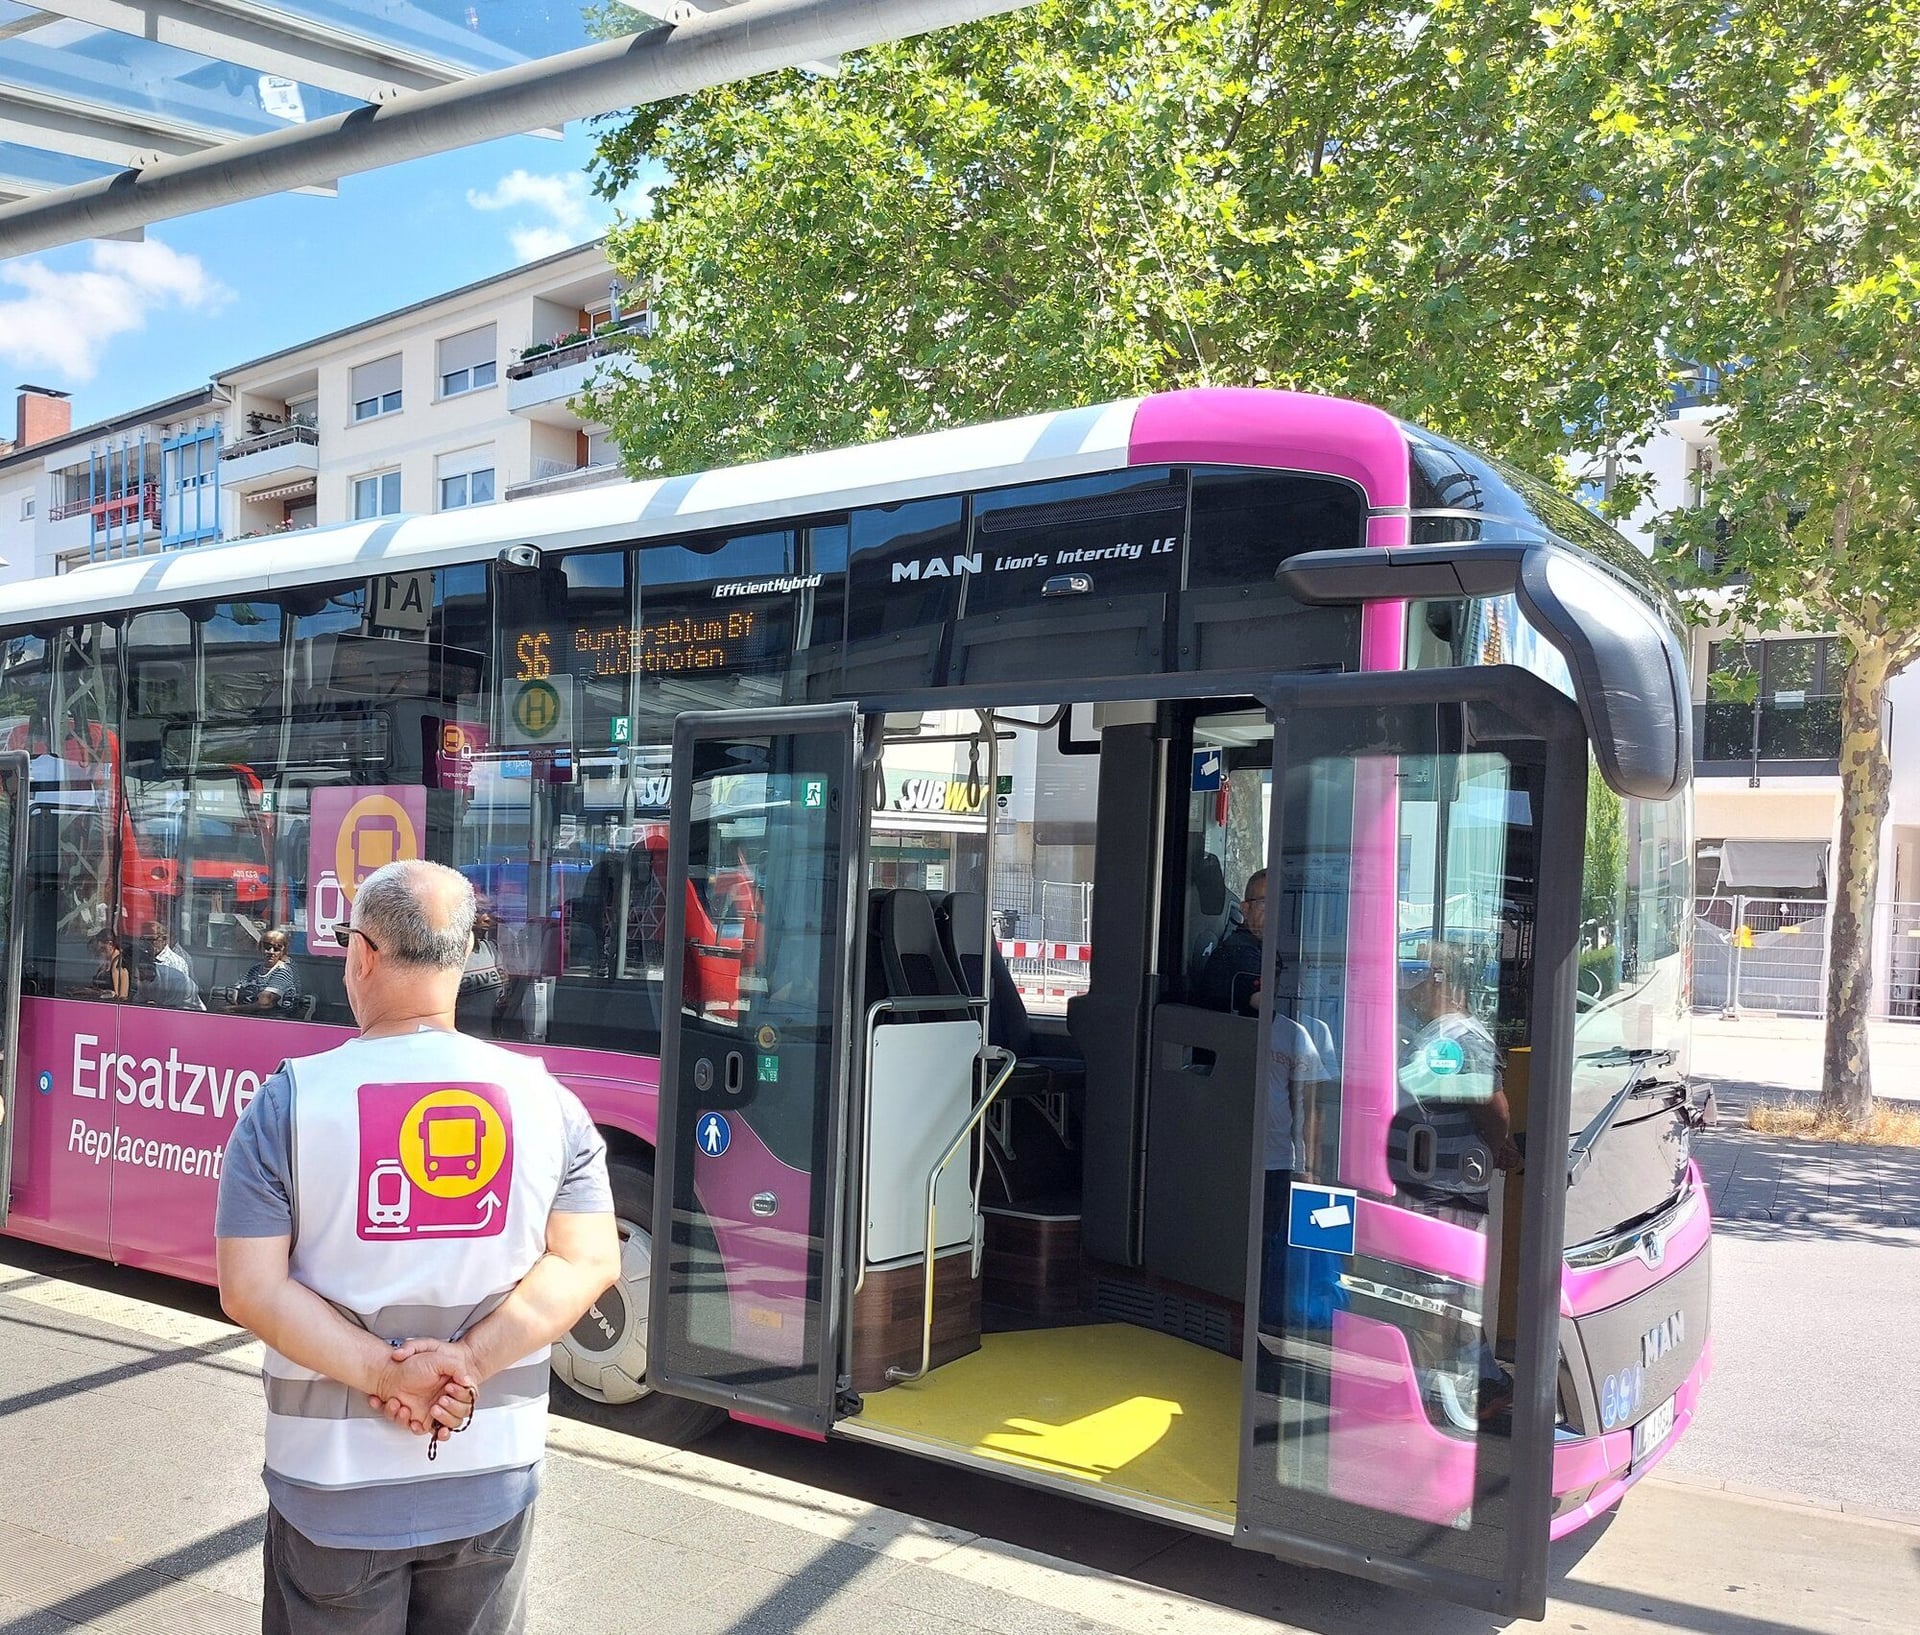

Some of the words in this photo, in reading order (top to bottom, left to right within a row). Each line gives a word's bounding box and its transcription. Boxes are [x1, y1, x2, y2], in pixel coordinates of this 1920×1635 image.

[715, 574, 822, 598] EfficientHybrid
[892, 553, 982, 582] MAN
[995, 553, 1048, 571] Lion's
[1056, 541, 1143, 565] Intercity
[1151, 537, 1175, 555] LE
[516, 633, 551, 681] S6
[575, 618, 722, 651] Guntersblum
[728, 612, 755, 638] Bf
[901, 779, 989, 812] SUBWAY
[72, 1033, 275, 1119] Ersatzve
[68, 1118, 223, 1180] Replacement
[1643, 1310, 1685, 1368] MAN
